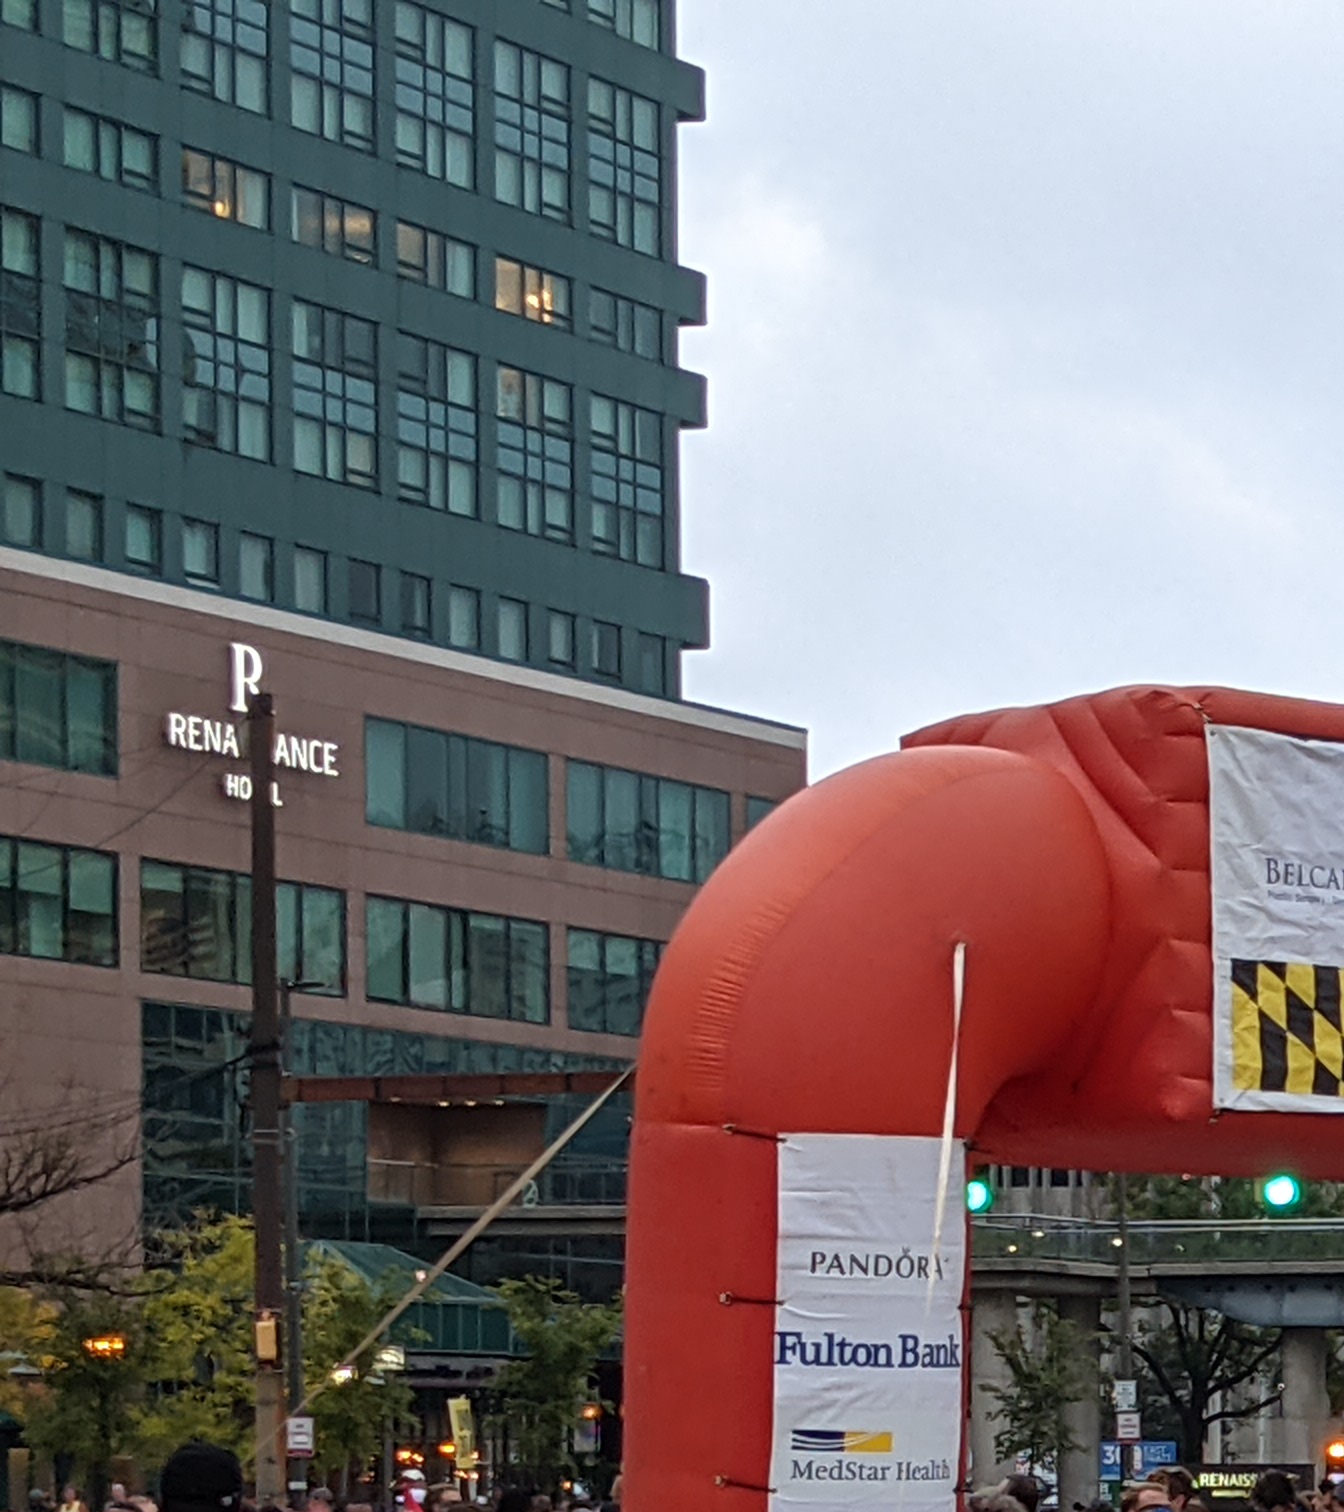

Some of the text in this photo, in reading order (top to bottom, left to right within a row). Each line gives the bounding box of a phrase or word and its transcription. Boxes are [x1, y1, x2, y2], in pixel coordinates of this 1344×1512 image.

[167, 711, 340, 777] RENAANCE
[224, 773, 284, 807] HOL
[775, 1331, 961, 1369] Fulton Bank
[790, 1458, 951, 1481] MedStar Health
[1200, 1473, 1258, 1488] RENAISS
